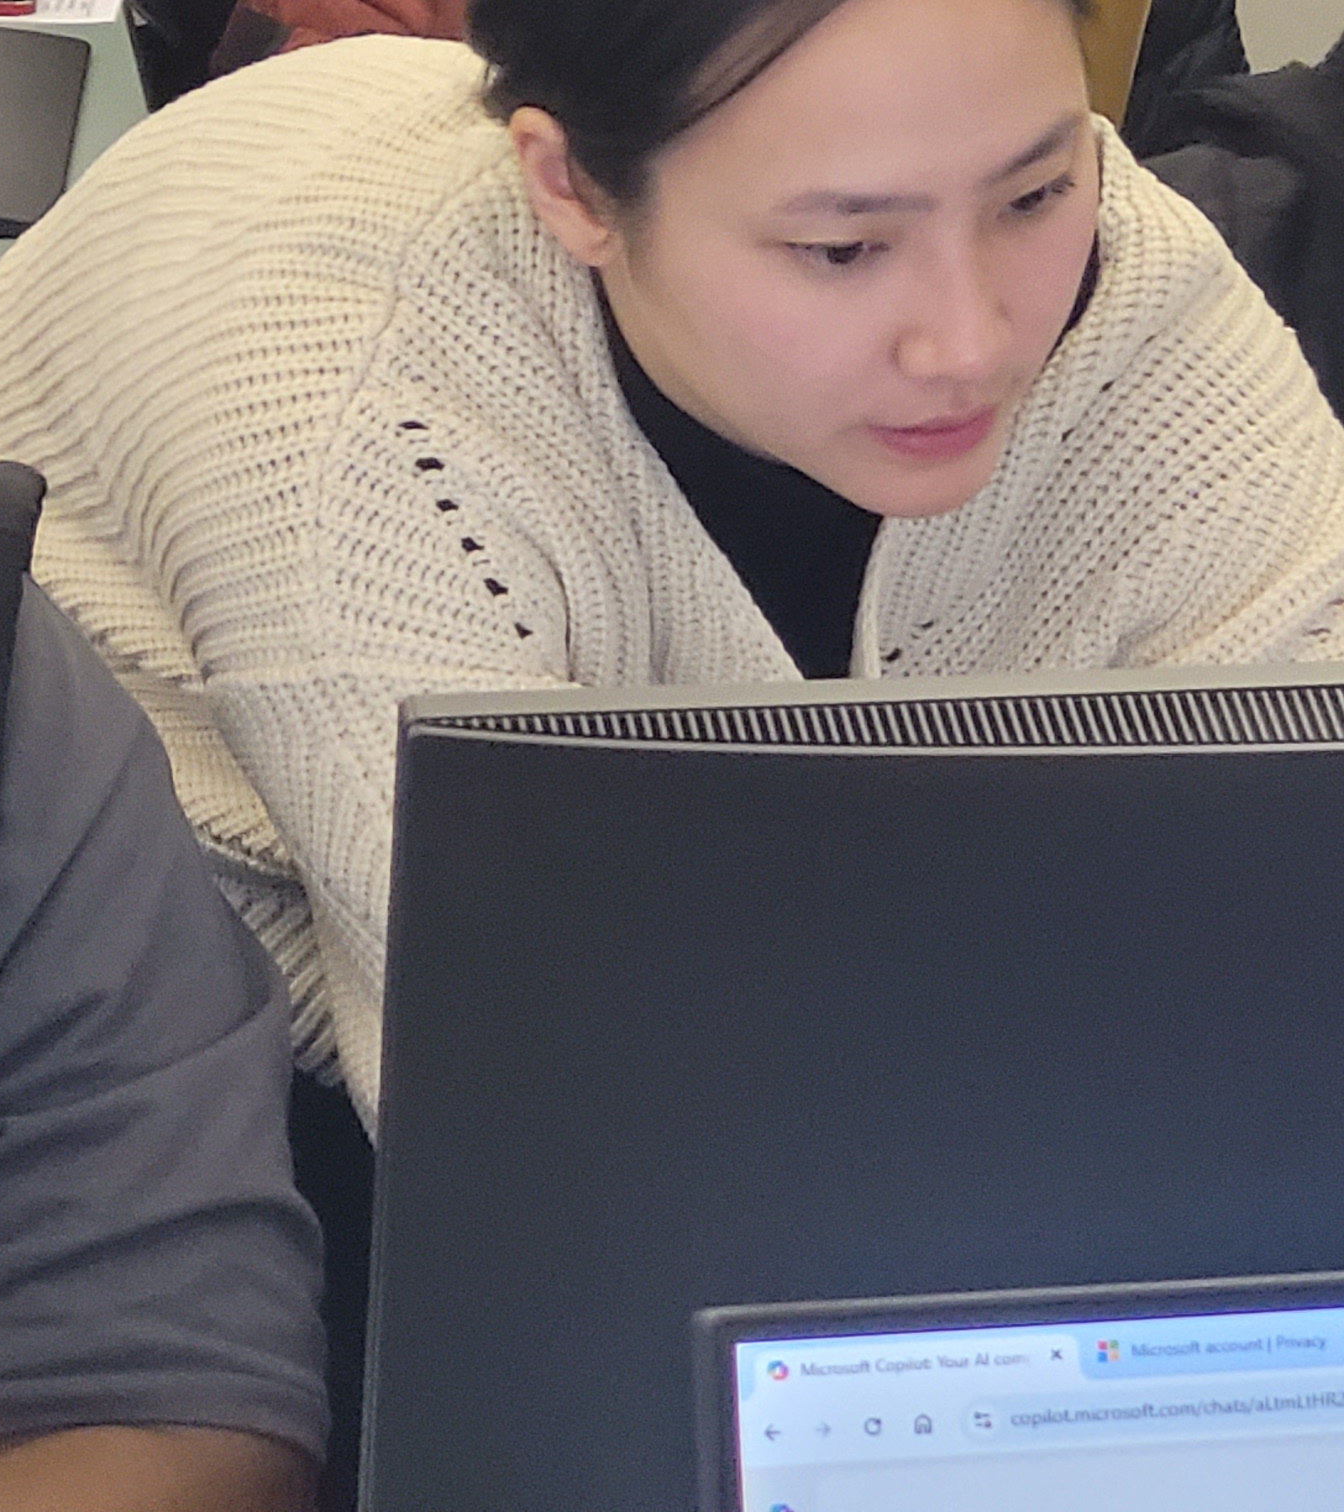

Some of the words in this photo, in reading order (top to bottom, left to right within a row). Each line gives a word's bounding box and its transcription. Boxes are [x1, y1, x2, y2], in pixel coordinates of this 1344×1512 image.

[1131, 1339, 1200, 1358] Microsoft
[1205, 1337, 1263, 1355] account
[1276, 1334, 1327, 1352] Privacy
[800, 1359, 870, 1377] Microsoft
[937, 1354, 969, 1369] Your
[974, 1352, 989, 1367] AI
[994, 1353, 1030, 1366] com
